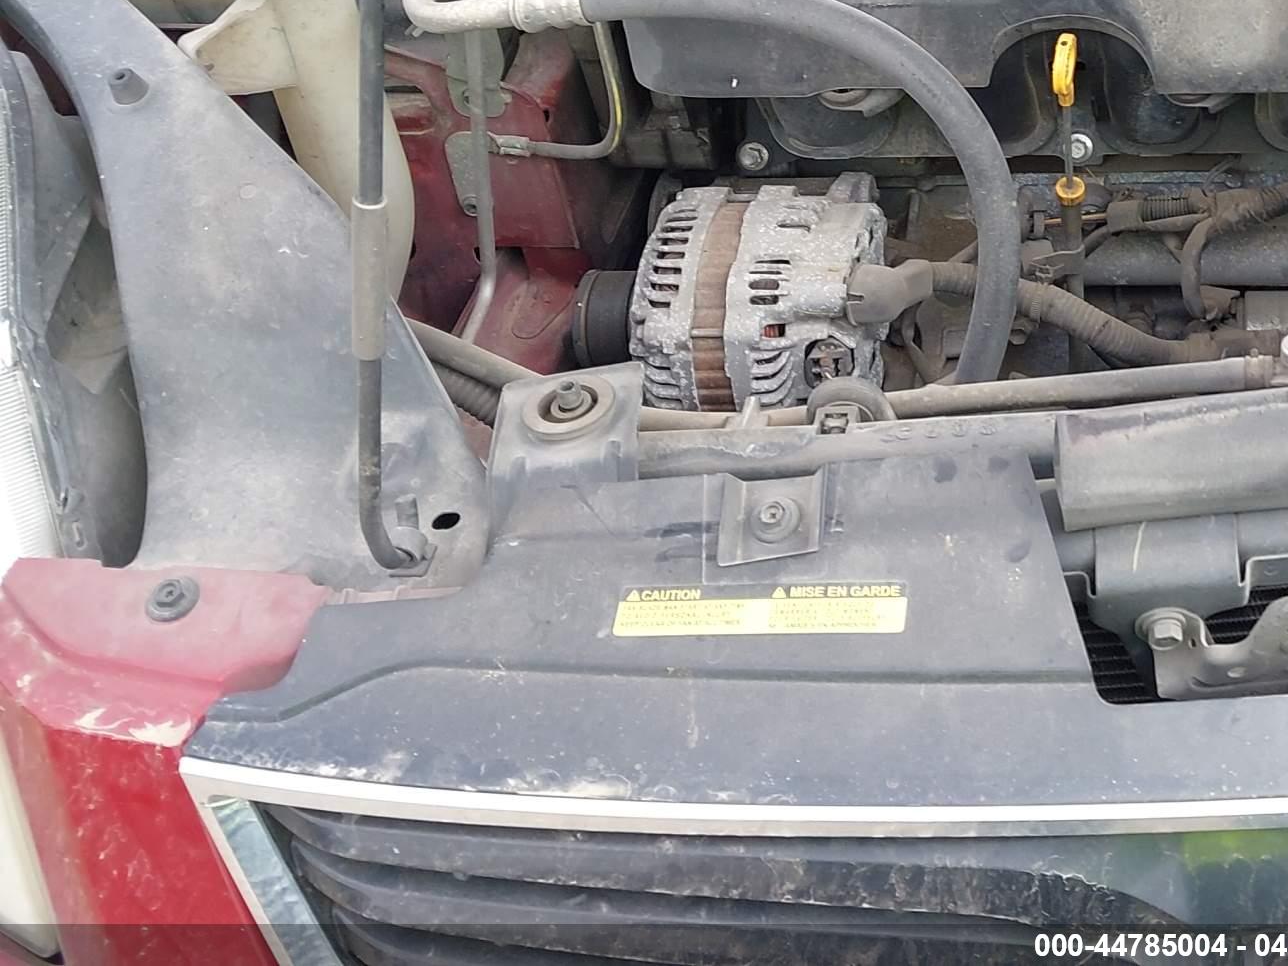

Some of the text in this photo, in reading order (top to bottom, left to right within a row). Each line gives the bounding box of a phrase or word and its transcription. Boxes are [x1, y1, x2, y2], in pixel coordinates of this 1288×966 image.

[641, 589, 701, 601] CAUTION
[790, 585, 901, 597] MISE EN GARDE
